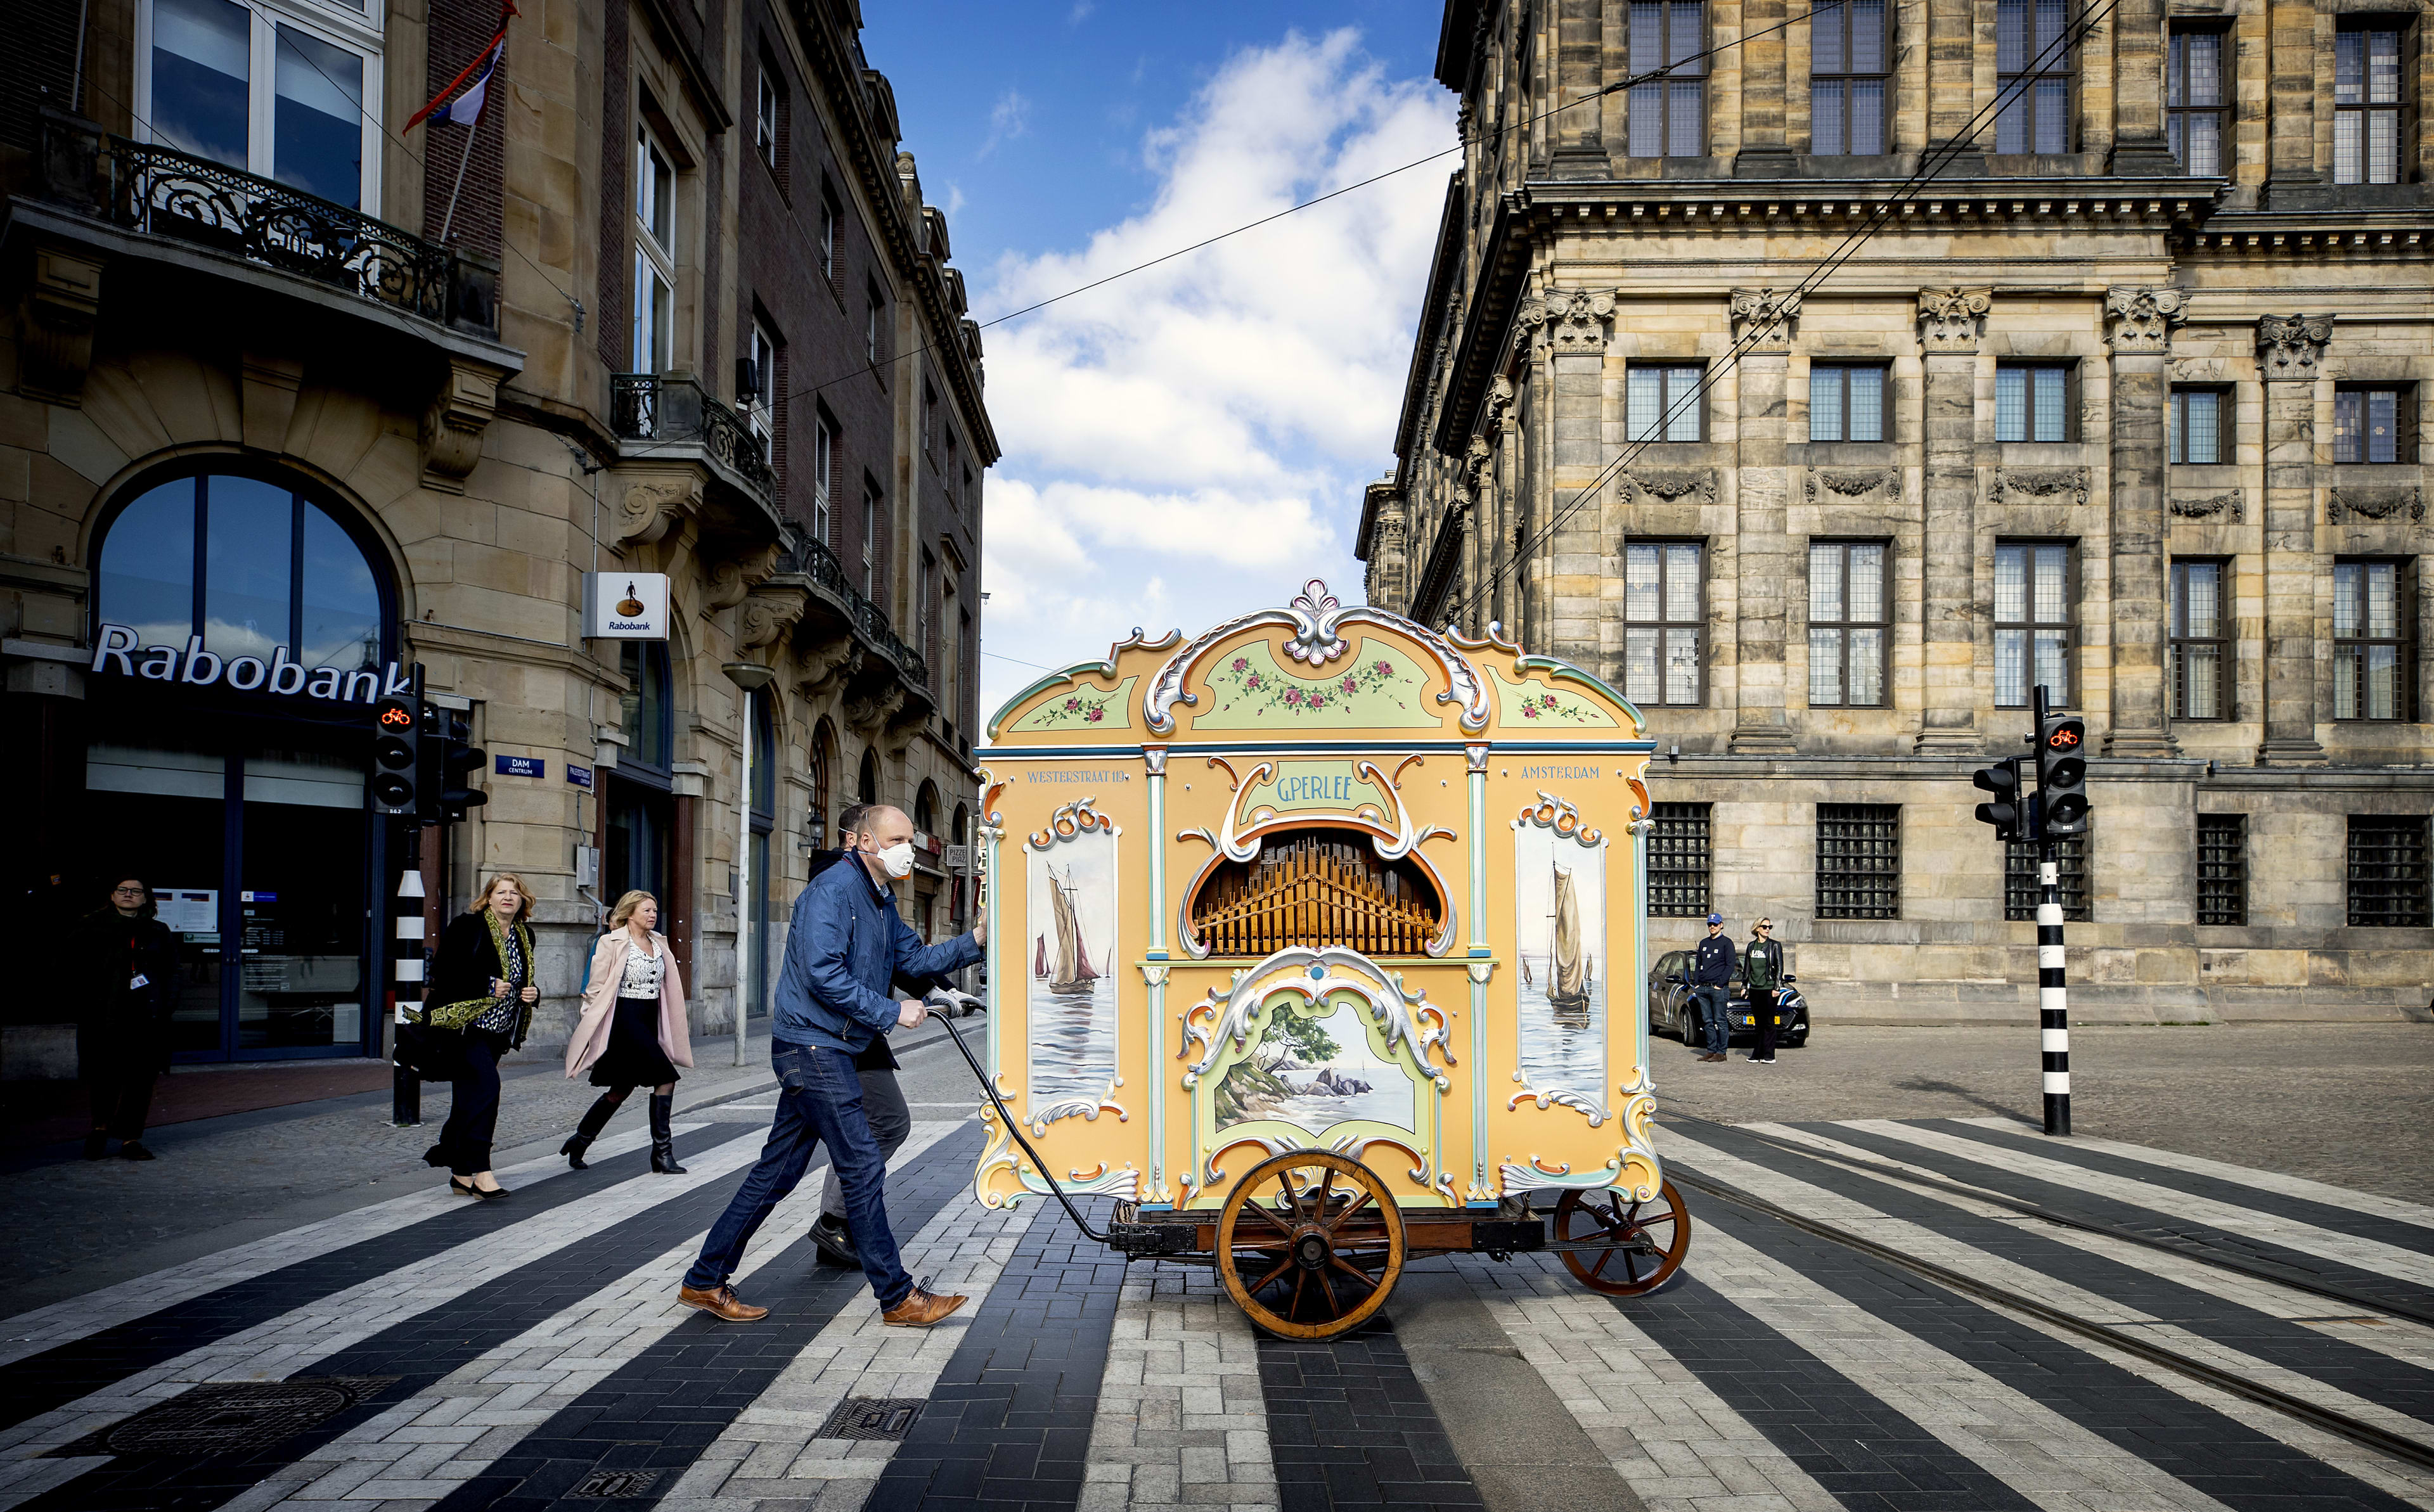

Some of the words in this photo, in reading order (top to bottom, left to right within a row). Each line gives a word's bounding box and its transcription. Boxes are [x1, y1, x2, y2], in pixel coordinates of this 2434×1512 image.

[608, 622, 650, 631] Rabobank
[512, 759, 530, 768] DAM
[1027, 771, 1108, 783] WESTERSTRAAT
[1522, 766, 1600, 779] AMSTERDAM
